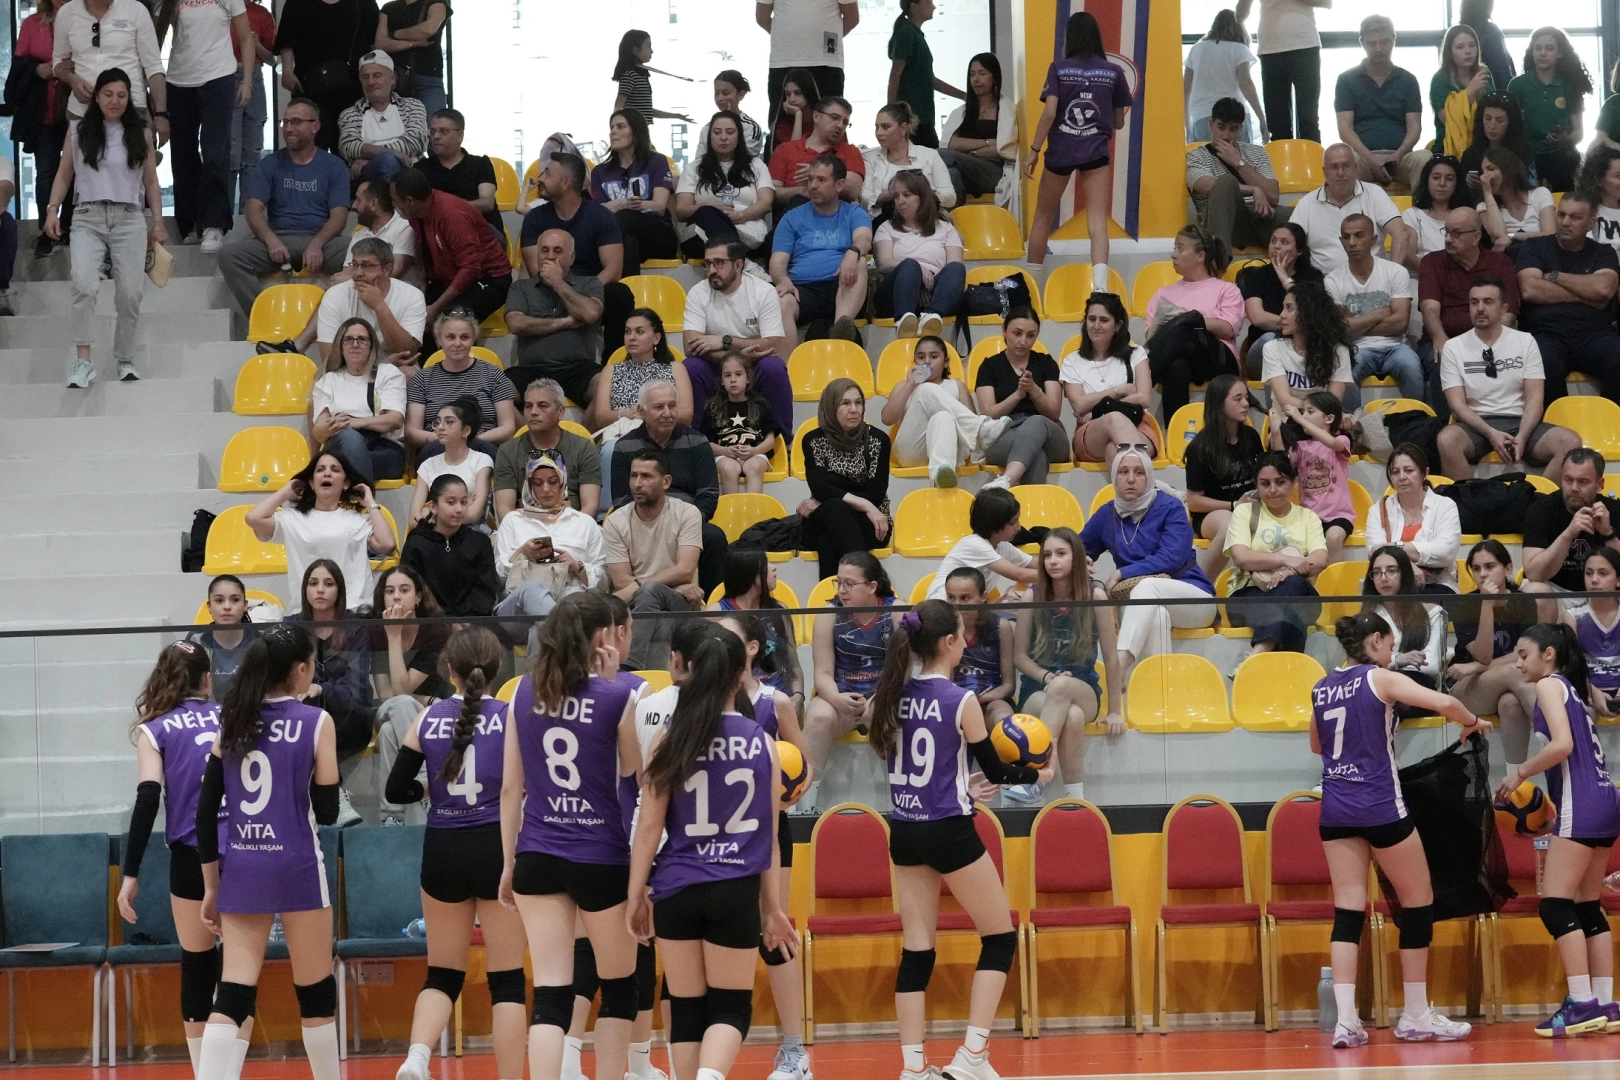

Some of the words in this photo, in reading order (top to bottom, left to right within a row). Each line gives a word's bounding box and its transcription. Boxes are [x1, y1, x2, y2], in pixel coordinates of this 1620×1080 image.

[162, 705, 222, 733] NEH
[898, 697, 942, 722] ENA
[268, 719, 303, 743] SU
[424, 713, 504, 740] ZERA
[1323, 706, 1347, 760] 7
[542, 726, 581, 791] 8
[888, 727, 936, 788] 19
[240, 749, 273, 816] 9
[446, 743, 484, 806] 4
[547, 792, 595, 813] VİTA
[683, 767, 760, 837] 12
[894, 790, 923, 809] VİTA
[236, 819, 276, 840] VİTA
[259, 844, 283, 853] YAŞAM
[695, 839, 740, 856] VİTA
